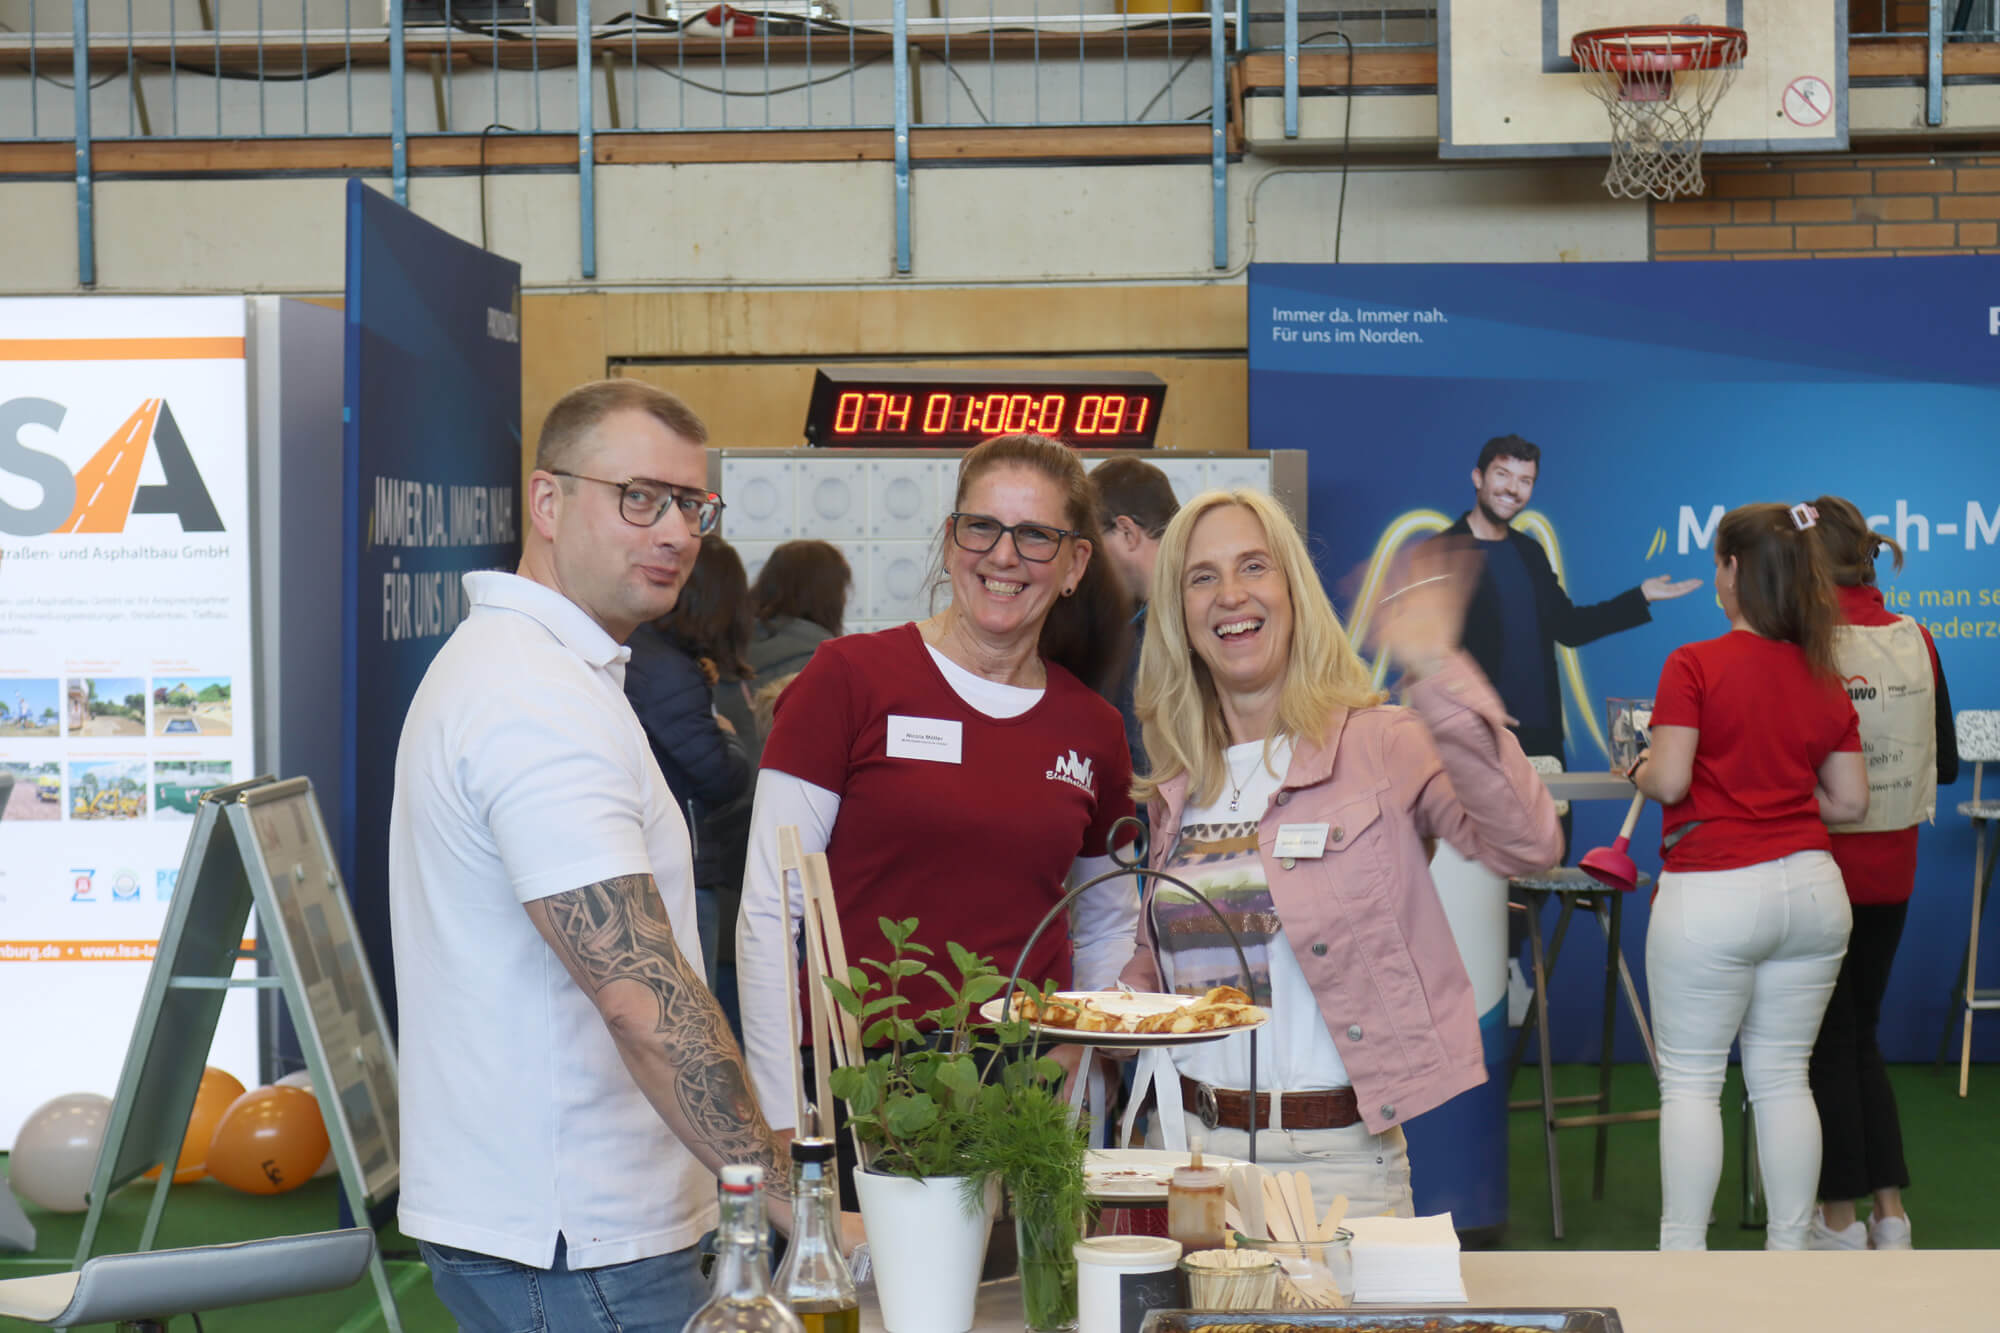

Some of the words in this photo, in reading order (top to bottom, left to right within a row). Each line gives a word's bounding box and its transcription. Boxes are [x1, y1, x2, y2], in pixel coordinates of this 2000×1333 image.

[1272, 307, 1325, 322] Immer
[1329, 307, 1354, 323] da.
[1357, 308, 1409, 323] Immer
[1413, 307, 1448, 323] nah.
[1272, 326, 1298, 342] Für
[1302, 330, 1331, 343] uns
[1335, 328, 1355, 343] im
[1359, 328, 1424, 344] Norden.
[834, 393, 912, 432] 074
[1075, 395, 1149, 434] 091
[375, 476, 424, 548] IMMER
[426, 483, 448, 548] DA.
[450, 485, 489, 546] IMMER
[59, 546, 88, 560] und
[92, 546, 179, 563] Asphaltbau
[182, 545, 230, 560] GmbH
[383, 556, 412, 642] FÜR
[414, 572, 442, 639] UNS
[1919, 588, 1971, 607] man
